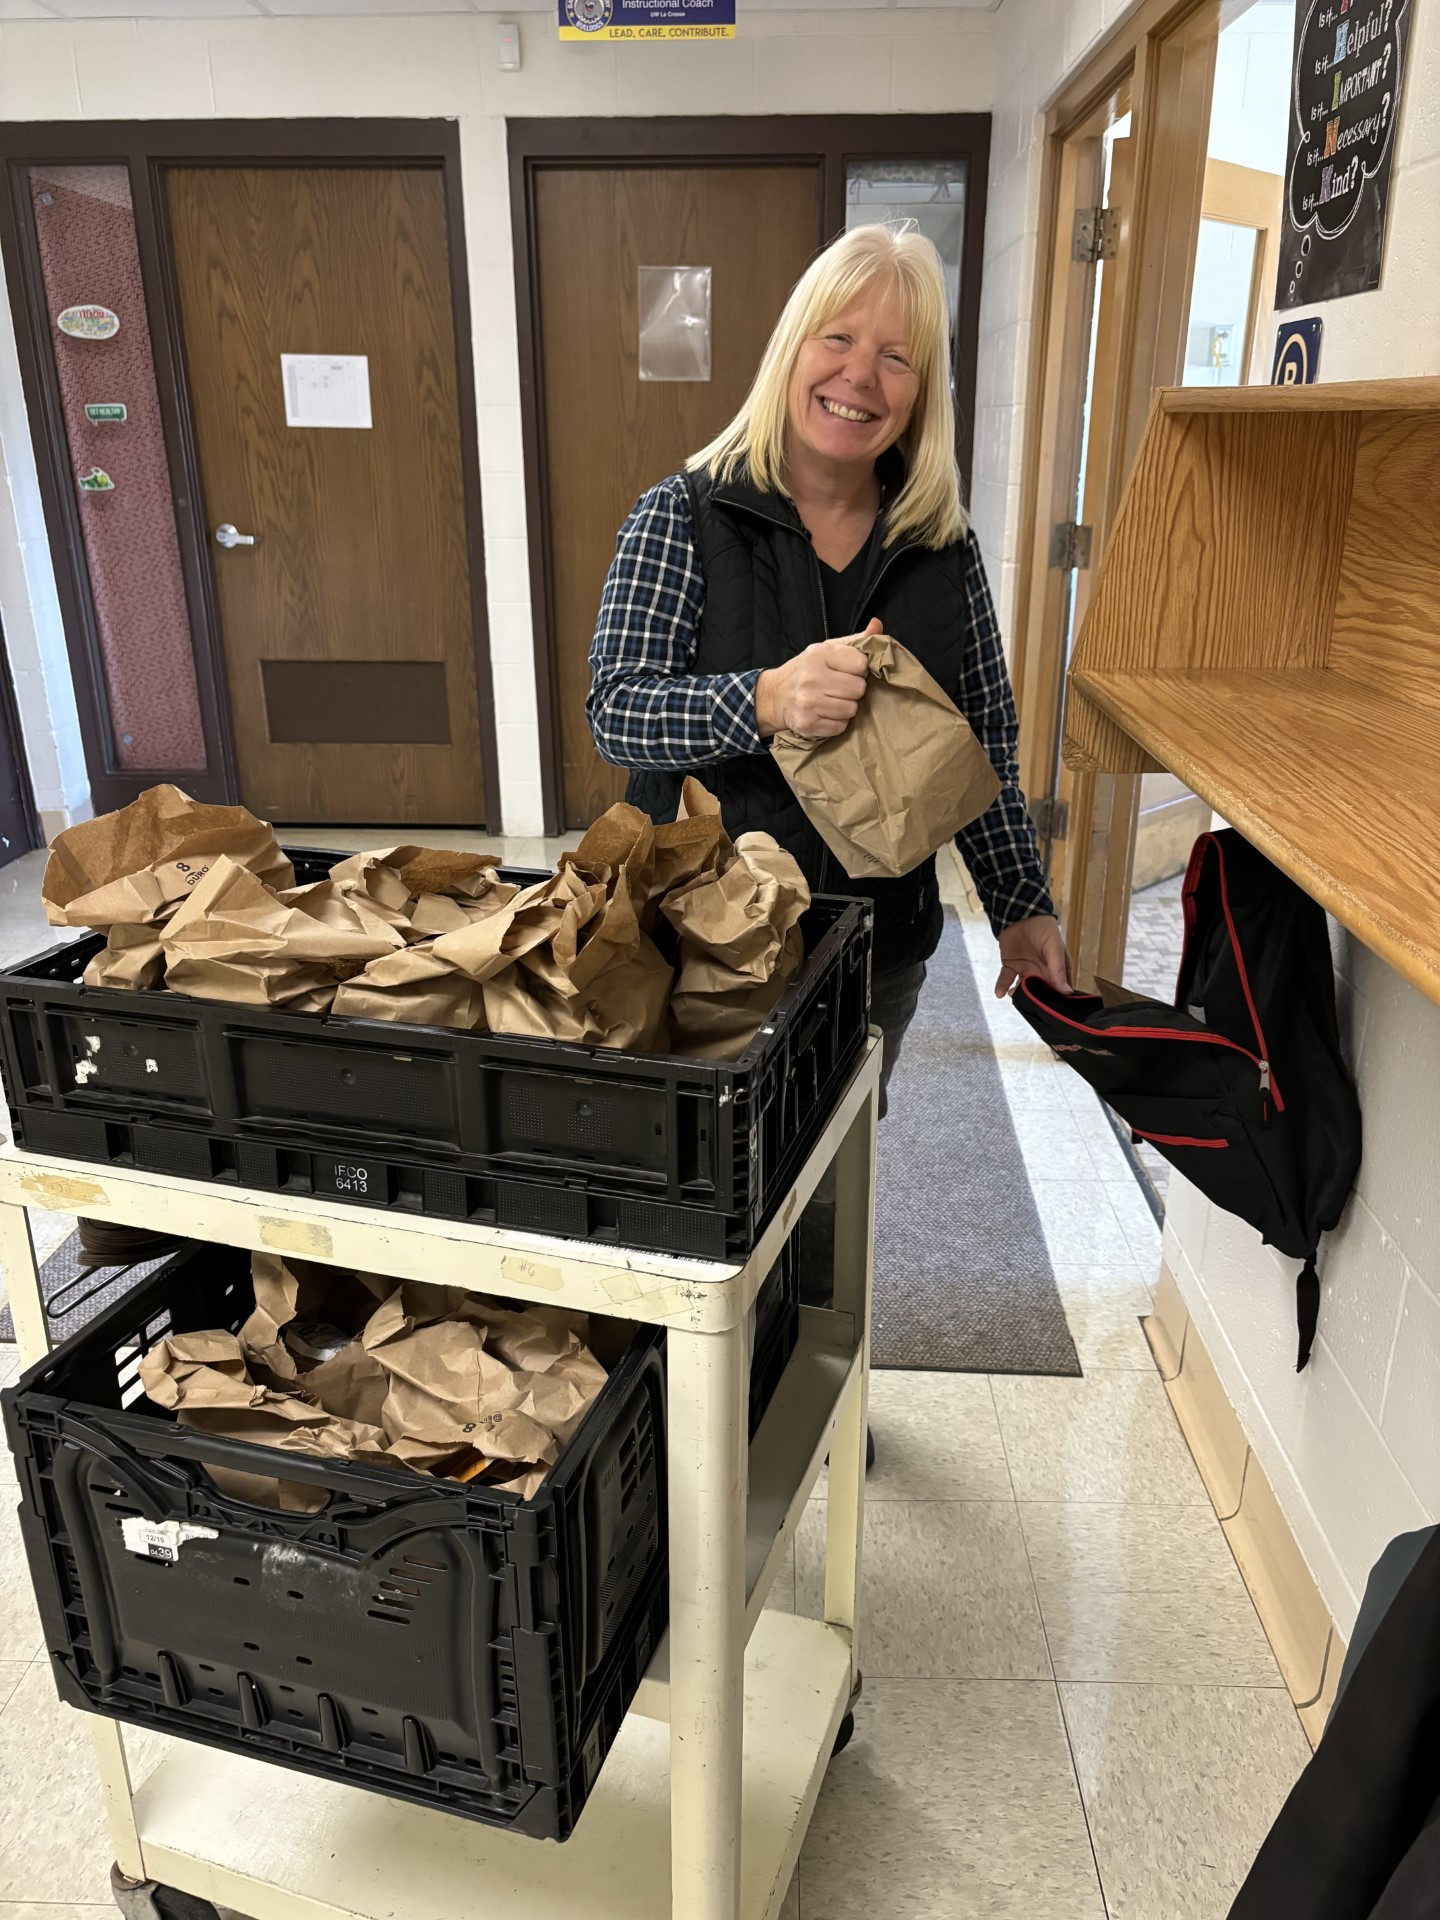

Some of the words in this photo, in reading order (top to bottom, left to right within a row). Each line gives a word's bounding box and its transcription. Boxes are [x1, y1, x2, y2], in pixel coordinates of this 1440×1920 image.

[622, 0, 679, 8] Instructional
[682, 0, 714, 8] Coach
[575, 20, 604, 31] BULLDOGS
[669, 27, 729, 37] CONTRIBUTE.
[1334, 0, 1393, 65] Helpful?
[1323, 91, 1390, 159] Necessary?
[1318, 155, 1359, 205] Kind?
[176, 862, 191, 873] 8
[187, 867, 209, 885] DURO
[334, 1164, 368, 1180] IFCO
[335, 1177, 368, 1193] 6413
[462, 1422, 477, 1433] 8
